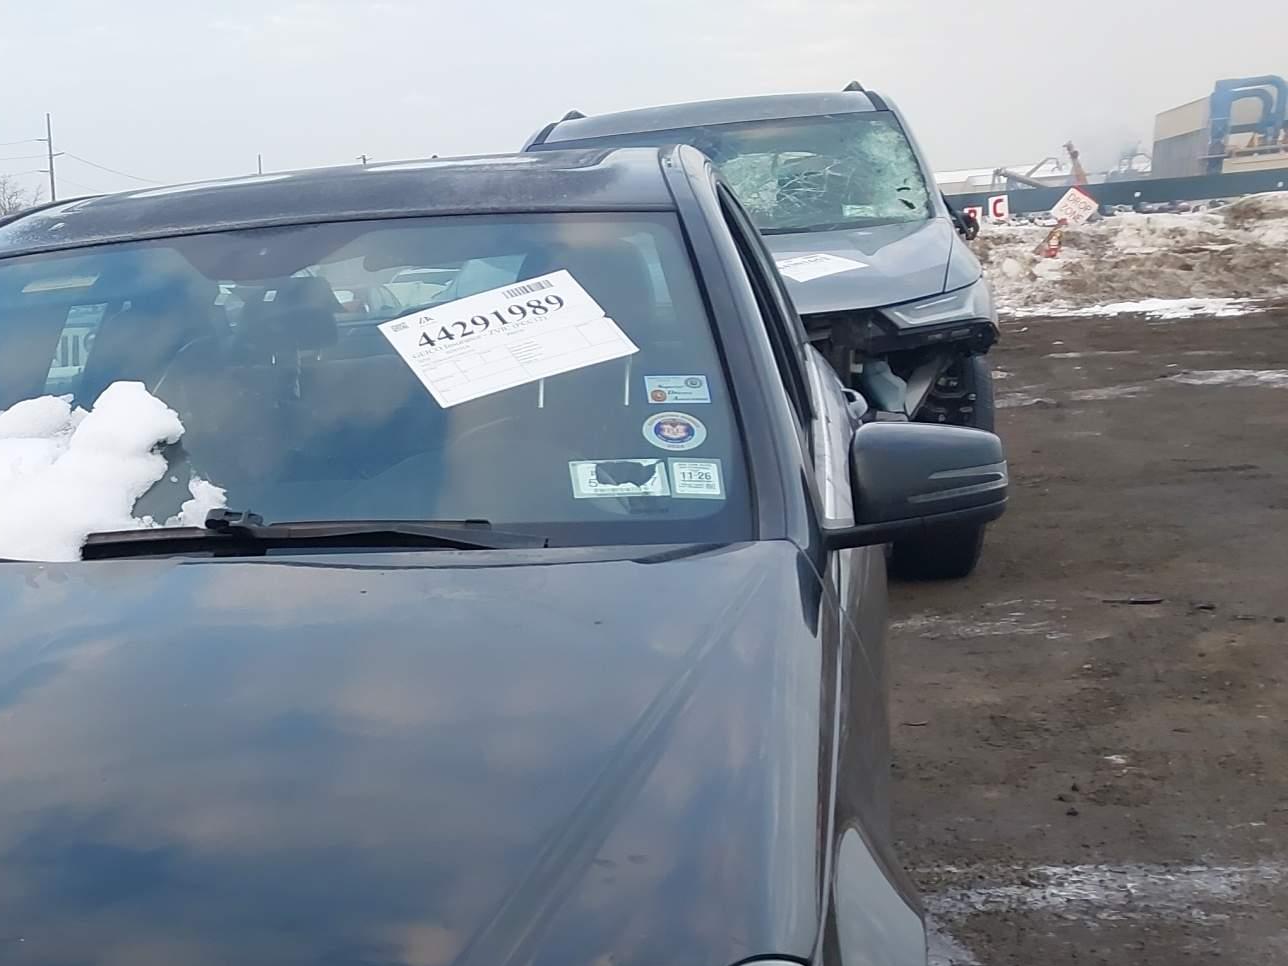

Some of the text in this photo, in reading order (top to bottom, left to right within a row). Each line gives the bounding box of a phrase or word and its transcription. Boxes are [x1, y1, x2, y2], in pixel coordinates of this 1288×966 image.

[993, 198, 1005, 218] C
[418, 294, 565, 347] 44291989
[681, 471, 713, 481] 11-26
